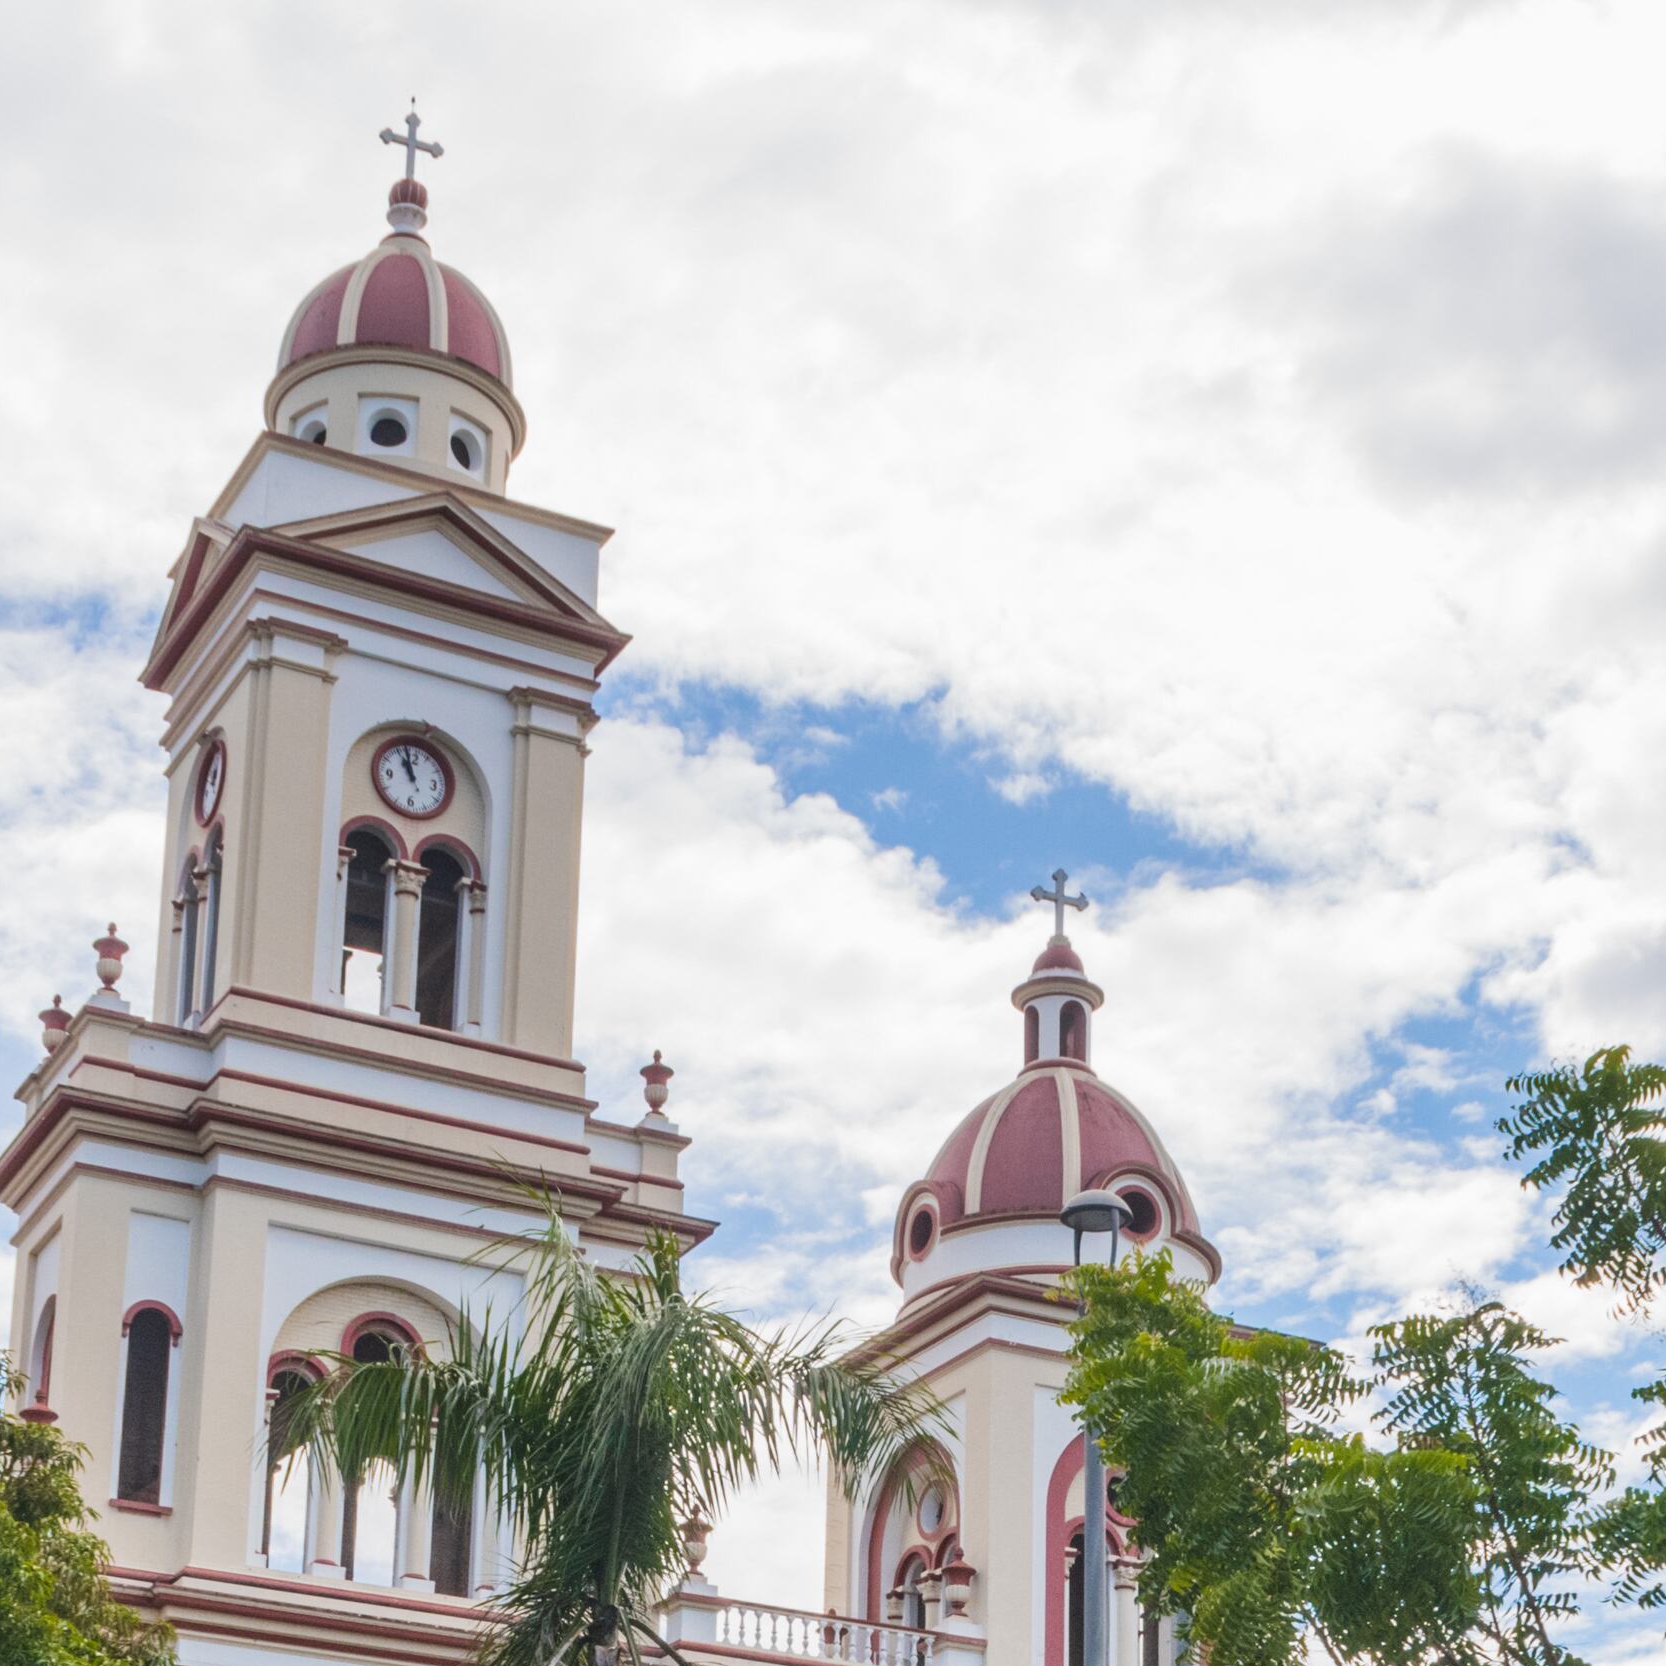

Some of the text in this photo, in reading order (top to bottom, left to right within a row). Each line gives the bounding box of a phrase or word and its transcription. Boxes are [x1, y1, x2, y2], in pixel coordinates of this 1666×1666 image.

[386, 768, 393, 779] 9
[430, 779, 437, 791] 3
[407, 795, 414, 806] 6
